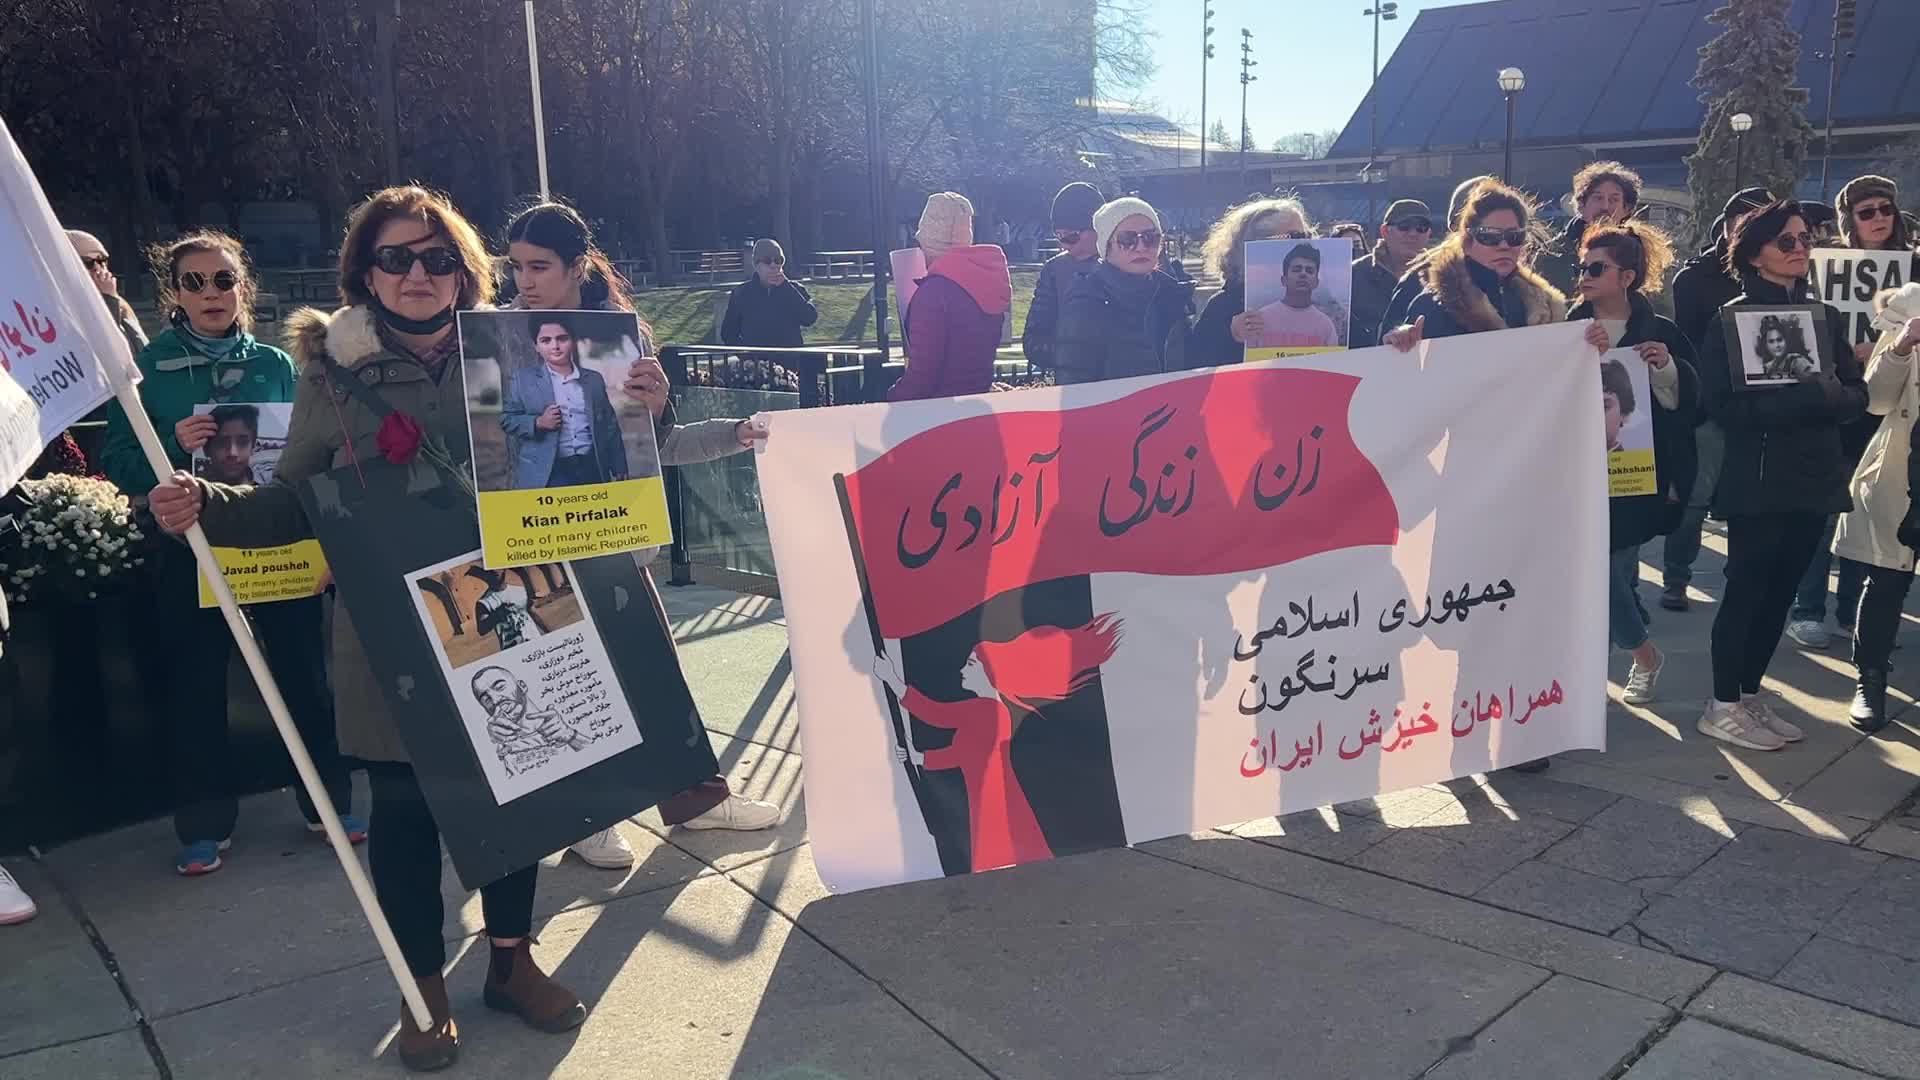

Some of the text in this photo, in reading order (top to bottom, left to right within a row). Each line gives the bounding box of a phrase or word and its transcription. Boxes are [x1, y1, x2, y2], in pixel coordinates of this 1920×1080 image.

[897, 403, 1323, 568] زن زندگی آزادی
[536, 490, 608, 507] 10 years old
[521, 505, 629, 529] Kian Pirfalak
[506, 522, 648, 548] One of many children
[506, 534, 650, 562] killed by Islamic Republic
[223, 563, 258, 575] Javad
[239, 581, 249, 589] of
[252, 580, 277, 588] many
[239, 592, 249, 600] by
[1233, 576, 1516, 662] جمهوری اسلامی
[556, 679, 573, 691] موش
[1238, 649, 1390, 715] سرنگون
[605, 724, 623, 738] موش
[1240, 679, 1564, 778] همراهان خیزش ایران
